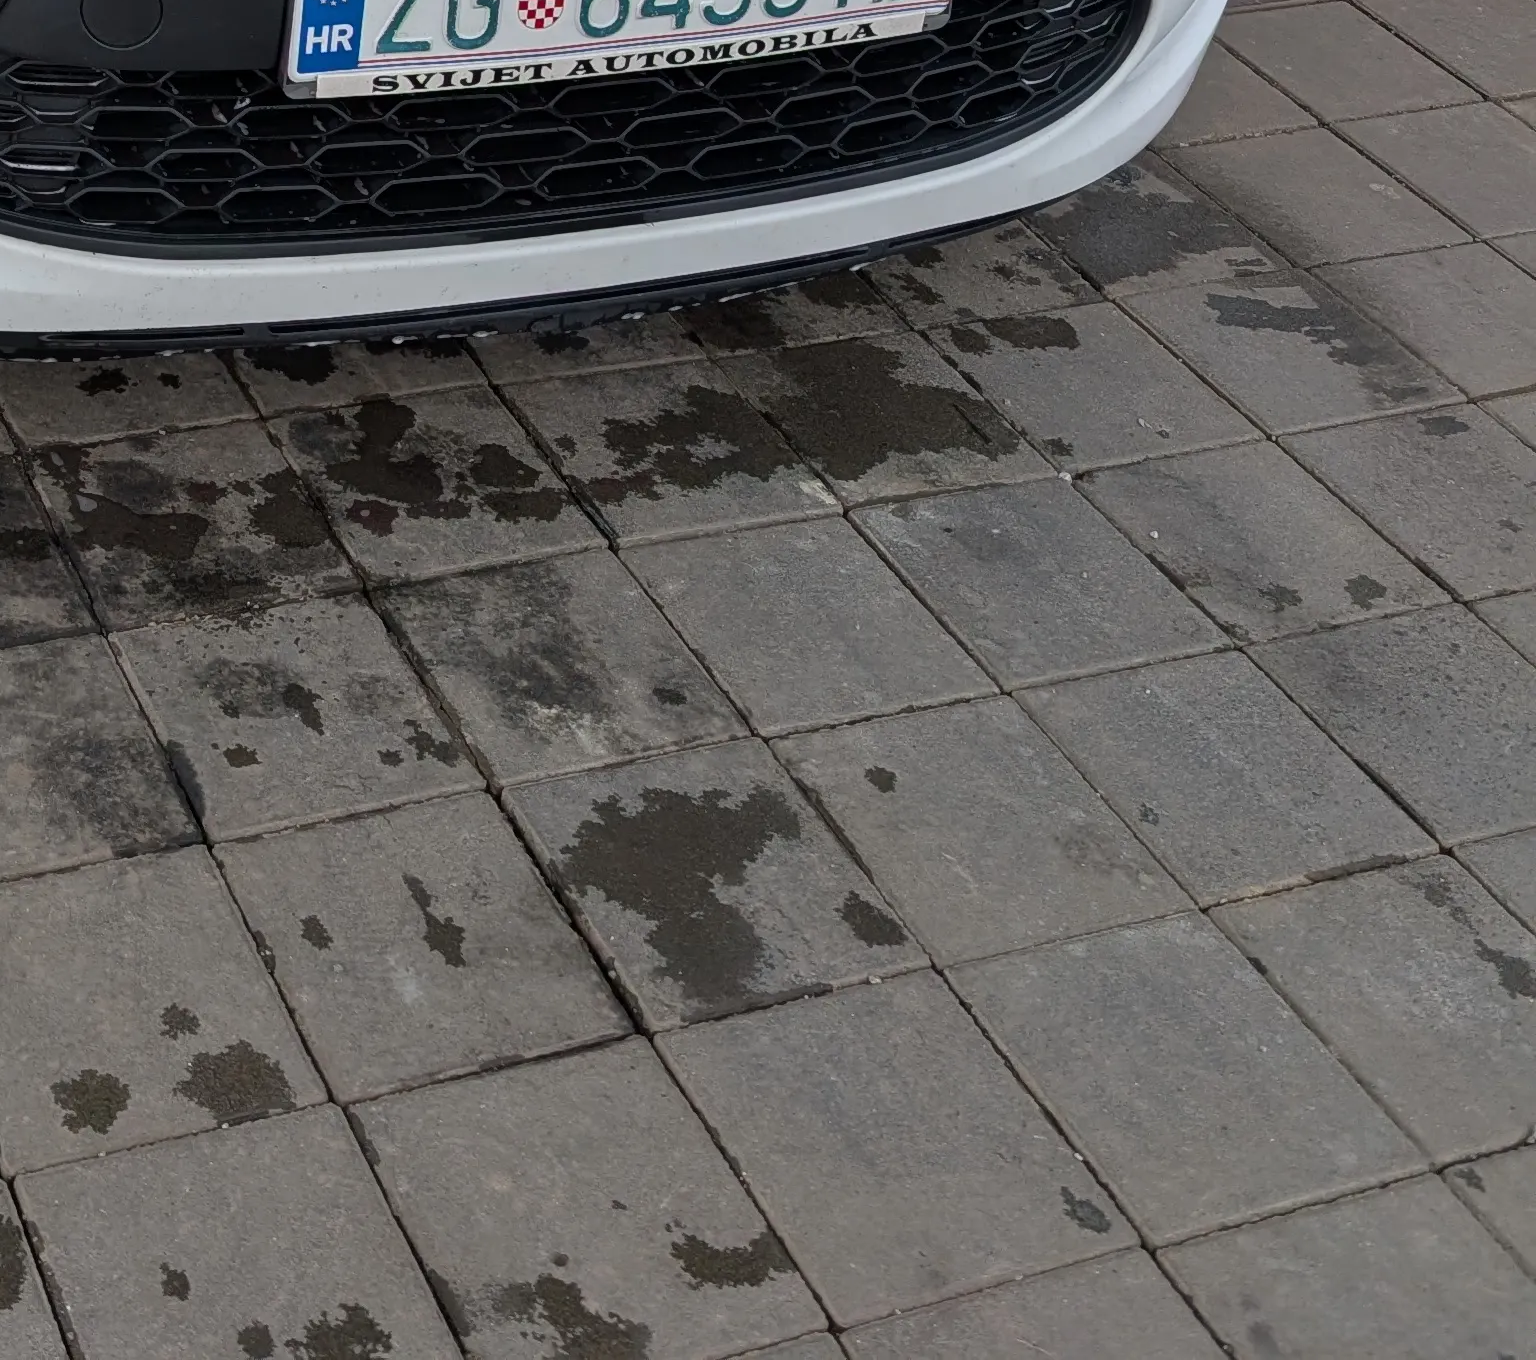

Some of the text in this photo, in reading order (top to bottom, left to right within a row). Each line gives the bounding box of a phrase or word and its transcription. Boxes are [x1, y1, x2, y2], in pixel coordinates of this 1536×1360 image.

[304, 23, 355, 55] HR
[371, 22, 879, 93] SVIJET AUTOMOBILA
